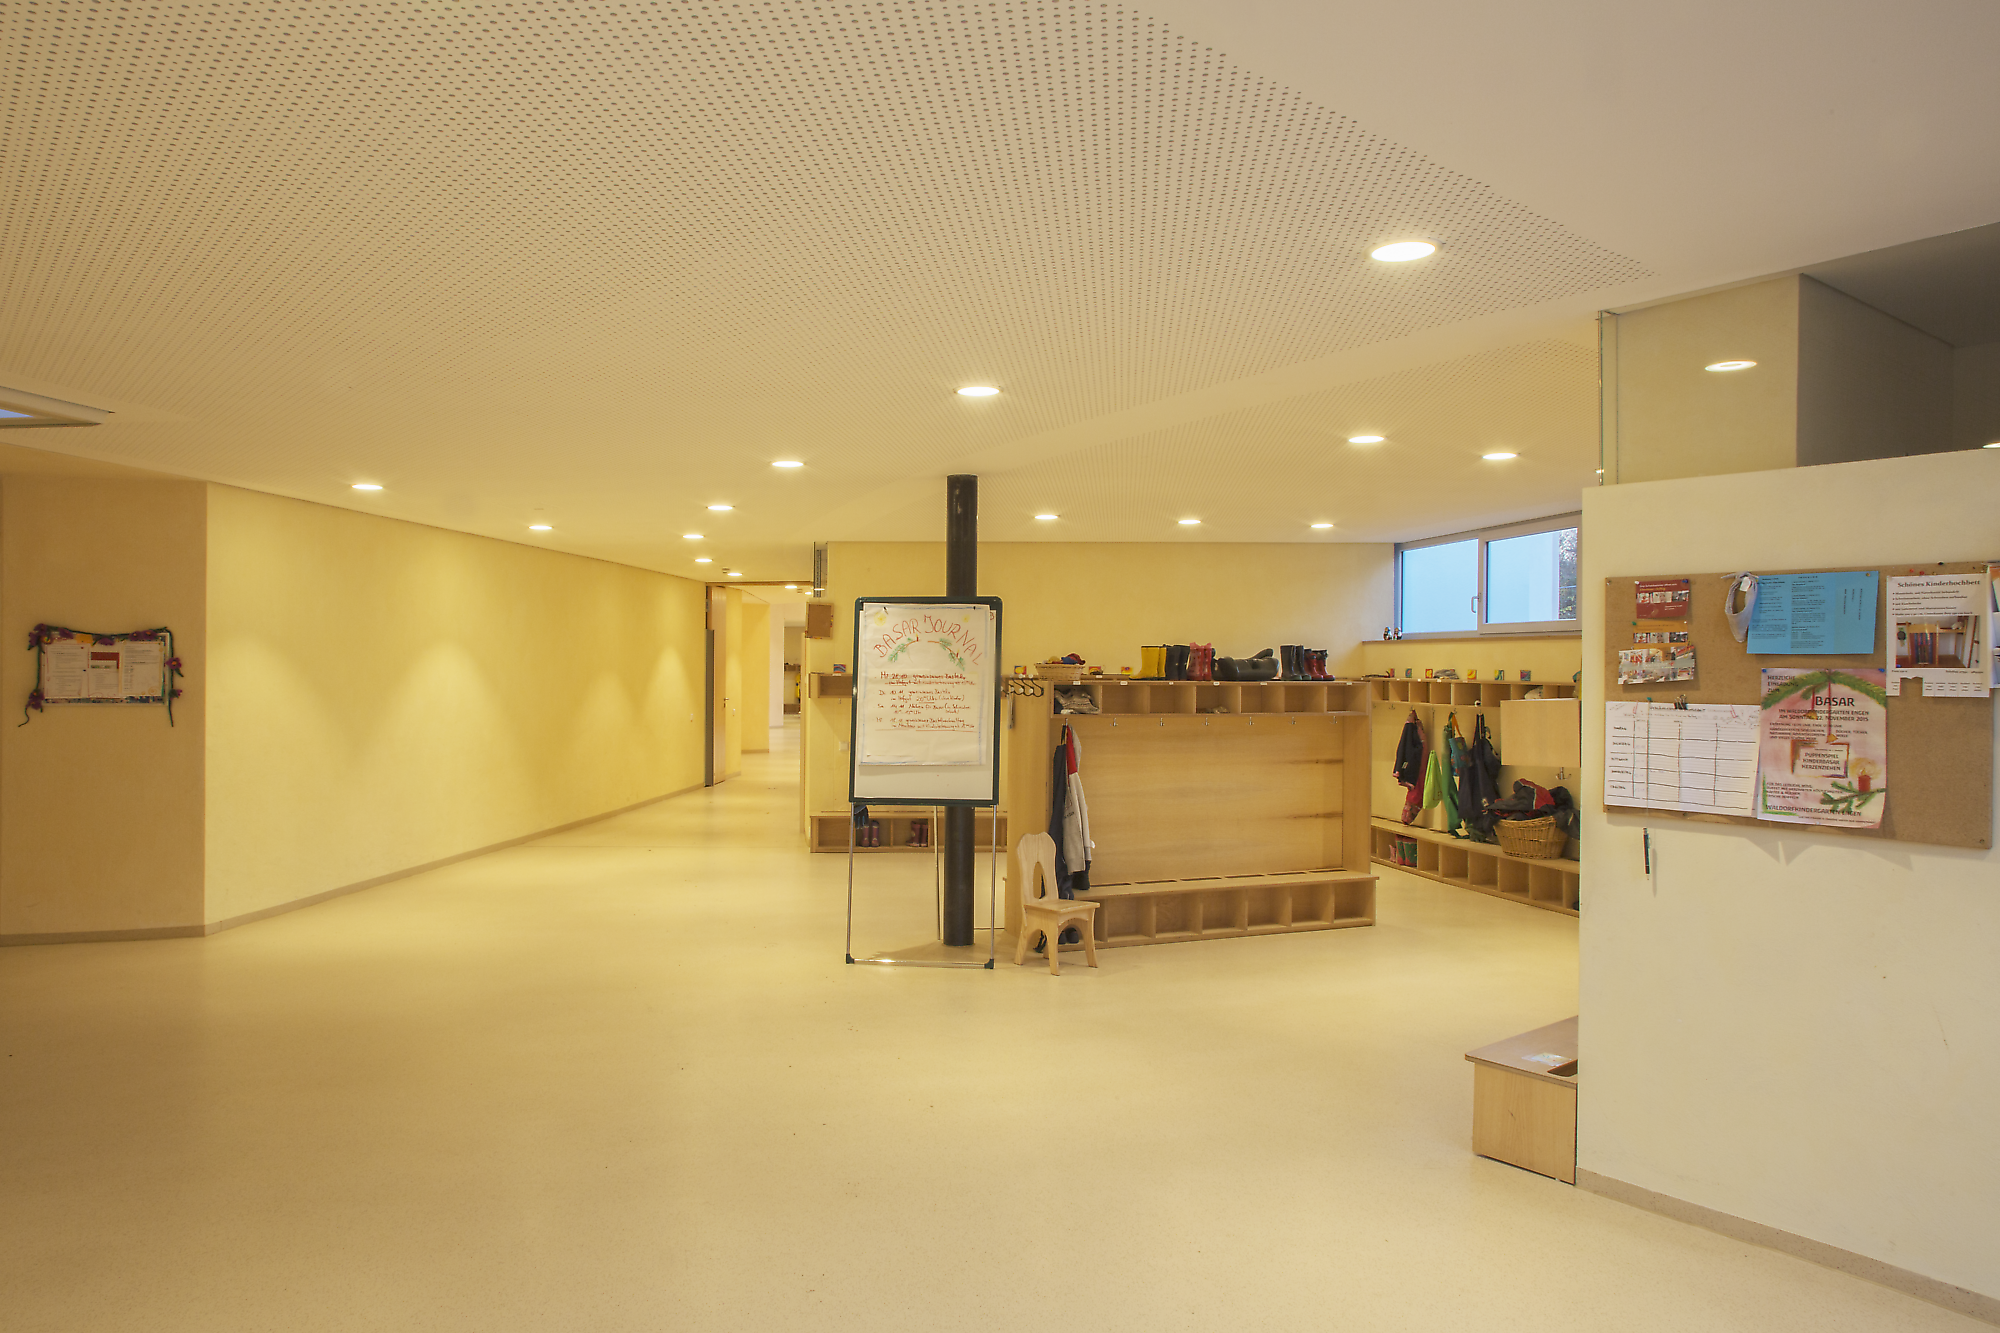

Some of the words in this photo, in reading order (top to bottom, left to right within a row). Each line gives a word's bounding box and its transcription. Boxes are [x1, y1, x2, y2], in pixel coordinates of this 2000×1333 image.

[1925, 579, 1981, 587] Kinderhochbett
[873, 618, 921, 658] BASAR
[924, 614, 982, 665] JOURNAL
[1815, 696, 1855, 707] BASAR
[1765, 804, 1840, 815] WALDORFKINDERGARTEN
